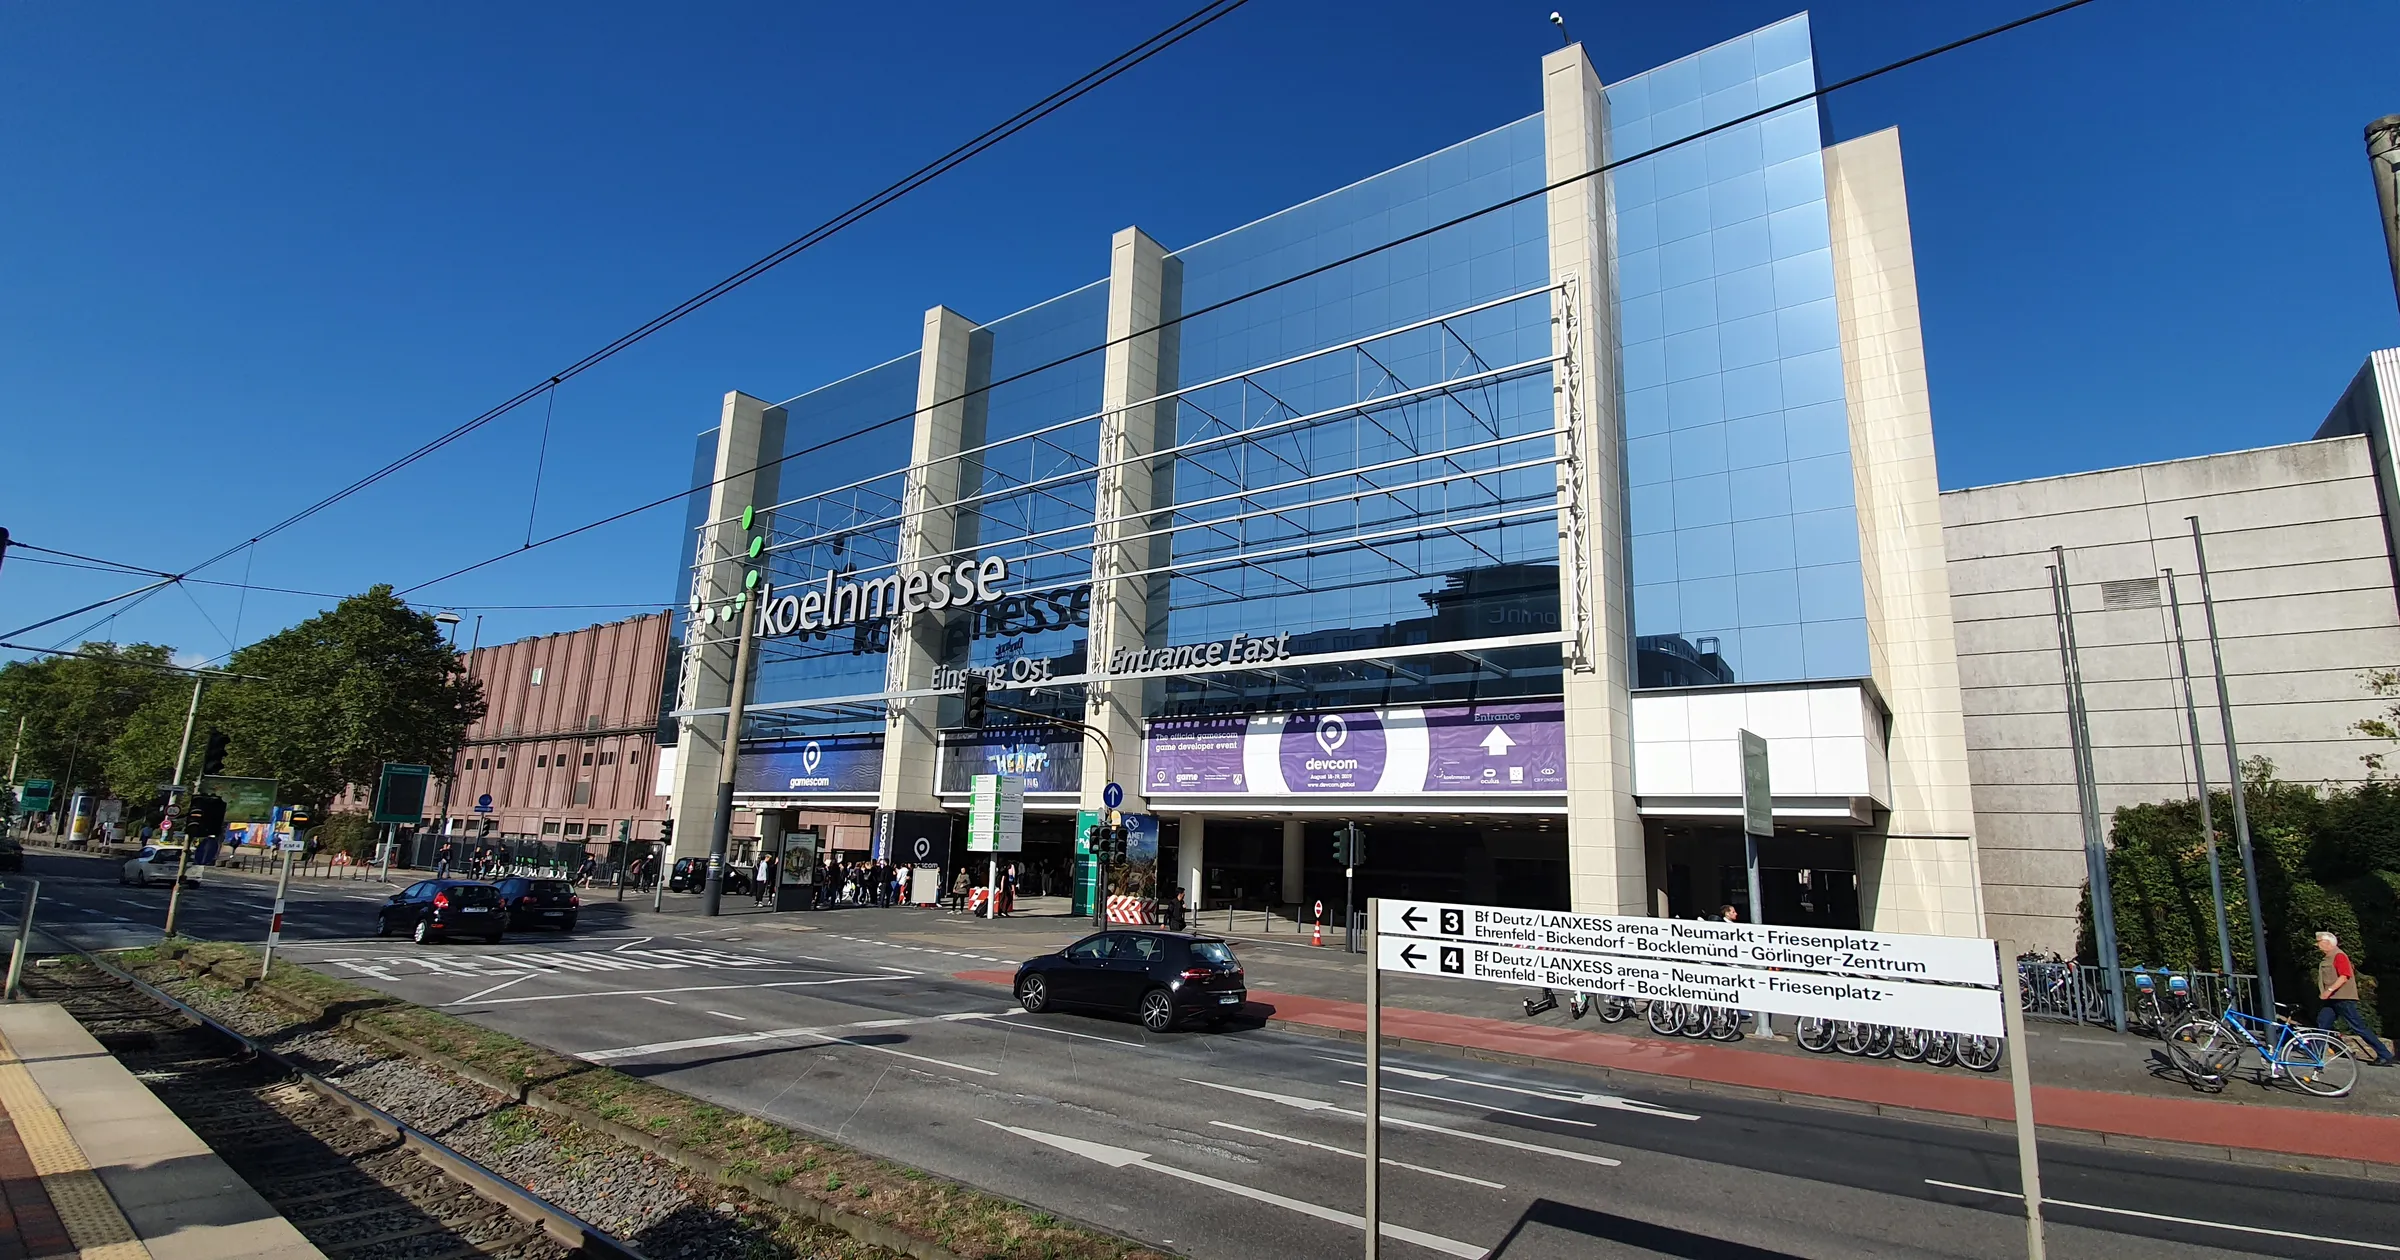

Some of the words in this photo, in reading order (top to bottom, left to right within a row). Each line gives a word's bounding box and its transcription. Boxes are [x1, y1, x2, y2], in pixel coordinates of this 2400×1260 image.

[758, 556, 1008, 637] koelnmesse
[1108, 645, 1222, 674] Entrance
[1227, 631, 1291, 664] East
[931, 663, 1008, 690] Eingng
[1012, 656, 1053, 683] Ost
[1474, 712, 1522, 722] Entrance
[1155, 744, 1176, 753] game
[1178, 743, 1214, 751] developer
[1216, 741, 1238, 750] event
[1305, 758, 1358, 770] devcom
[789, 777, 830, 789] gamescom
[1444, 911, 1459, 932] 3
[1475, 910, 1489, 923] Bf
[1493, 911, 1613, 932] Deutz/LANXESS
[1616, 923, 1659, 936] arena
[1767, 929, 1880, 952] Friesenplatz
[1444, 950, 1460, 971] 4
[1751, 946, 1926, 973] Görlinger-Zentrum
[1475, 949, 1489, 963] Bf
[1493, 951, 1613, 975] Deutz/LANXESS
[1617, 966, 1660, 980] arena
[1769, 976, 1882, 1001] Friesenplatz
[1637, 980, 1739, 1004] Bocklemünd
